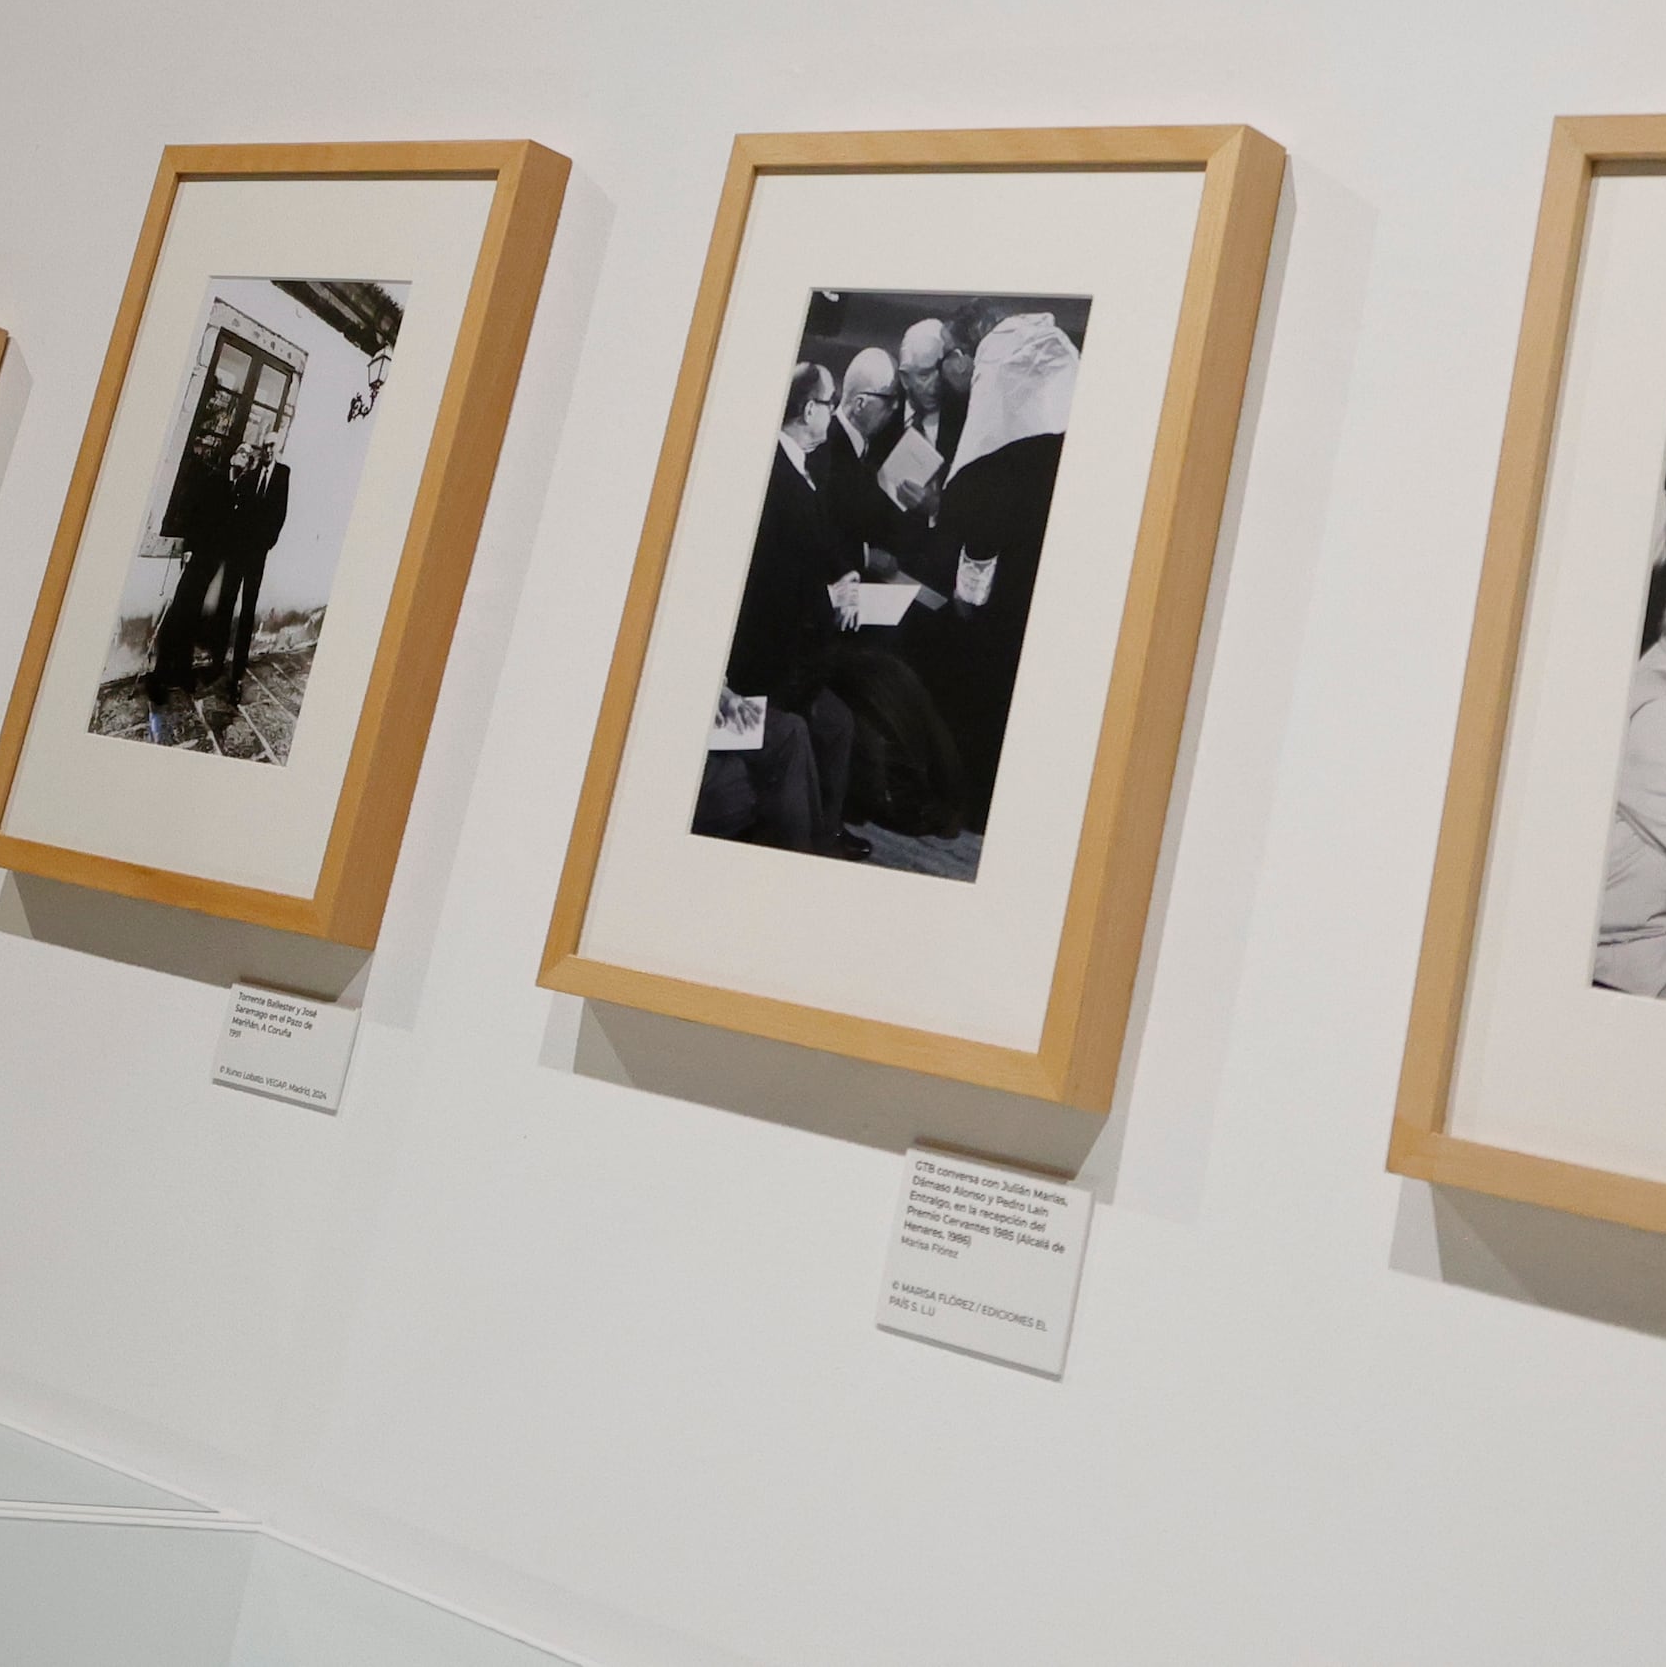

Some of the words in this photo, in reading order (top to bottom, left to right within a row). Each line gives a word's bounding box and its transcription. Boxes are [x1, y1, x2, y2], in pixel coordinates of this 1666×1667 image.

[239, 992, 265, 1006] Torrente
[267, 999, 294, 1013] Ballester
[915, 1160, 935, 1175] GTB
[937, 1167, 979, 1185] conversa
[981, 1178, 999, 1189] con
[912, 1176, 950, 1194] Dámaso
[953, 1186, 985, 1202] Alonso
[987, 1196, 993, 1206] y
[997, 1196, 1025, 1212] Pedro
[907, 1206, 940, 1221] Premio
[943, 1214, 990, 1235] Cervantes
[1052, 1242, 1065, 1254] de
[954, 1202, 966, 1213] en
[969, 1205, 976, 1215] la
[1030, 1220, 1045, 1232] del
[902, 1283, 935, 1302] MARISA
[982, 1305, 1033, 1328] EDICIONES
